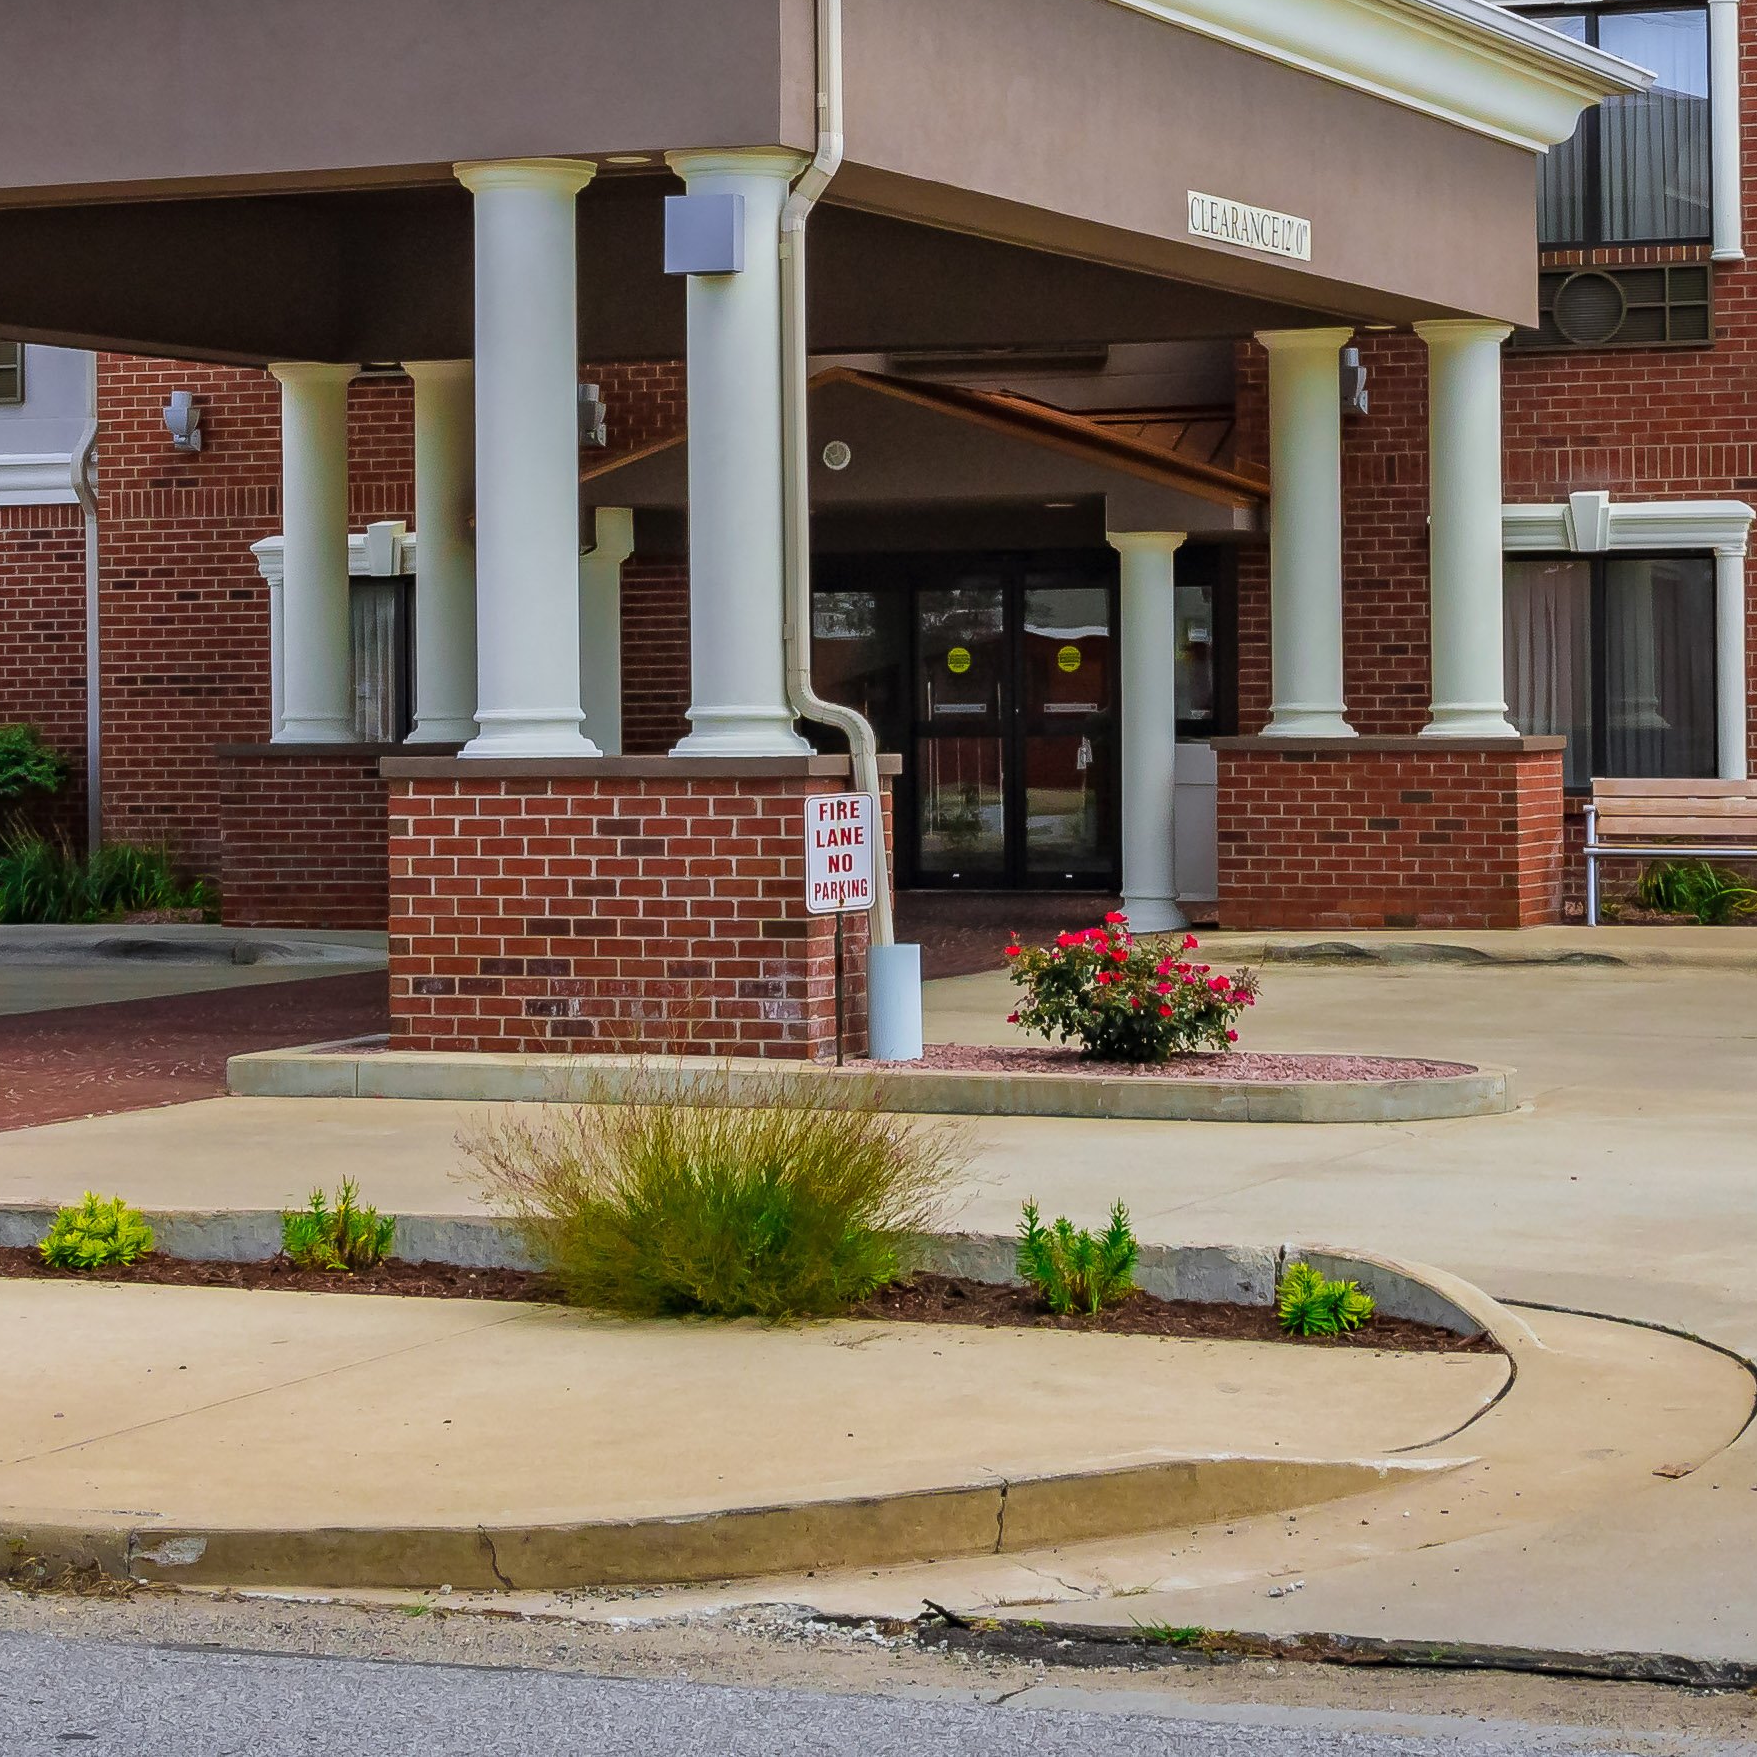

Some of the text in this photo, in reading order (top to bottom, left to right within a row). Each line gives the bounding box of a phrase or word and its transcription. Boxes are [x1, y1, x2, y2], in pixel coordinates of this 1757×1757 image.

[1190, 196, 1280, 249] CLEARANCE
[818, 800, 860, 822] FIRE
[816, 826, 864, 849] LANE
[827, 853, 853, 874] NO
[814, 878, 868, 902] PARKING
